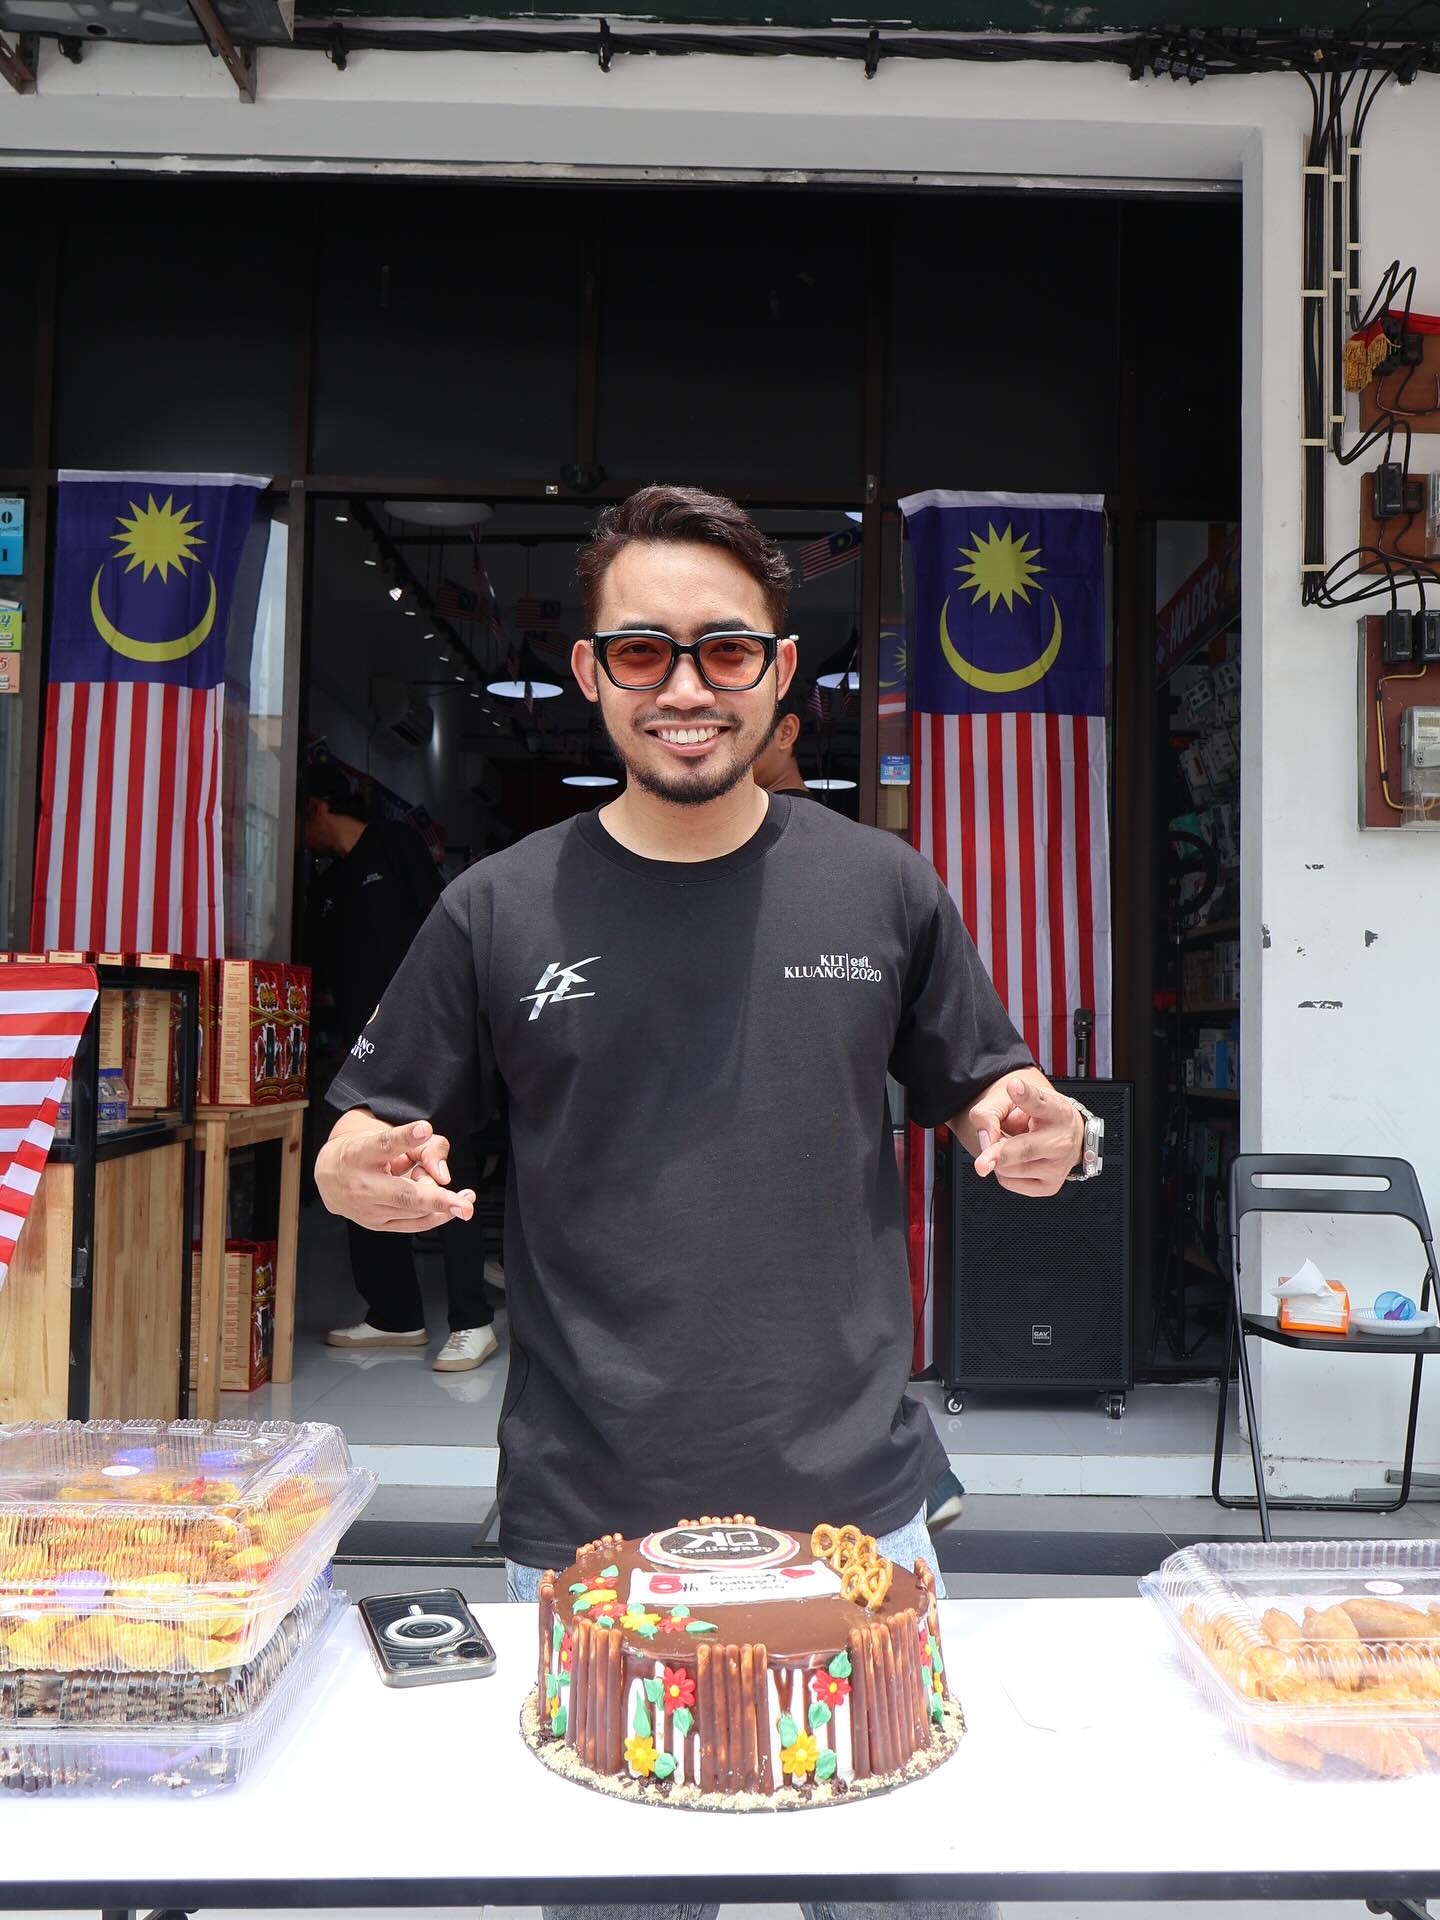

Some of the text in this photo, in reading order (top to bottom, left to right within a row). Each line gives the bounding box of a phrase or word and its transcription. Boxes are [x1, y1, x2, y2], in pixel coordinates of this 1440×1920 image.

[1169, 560, 1219, 655] HOLDER
[784, 966, 882, 982] KLUANG 2020
